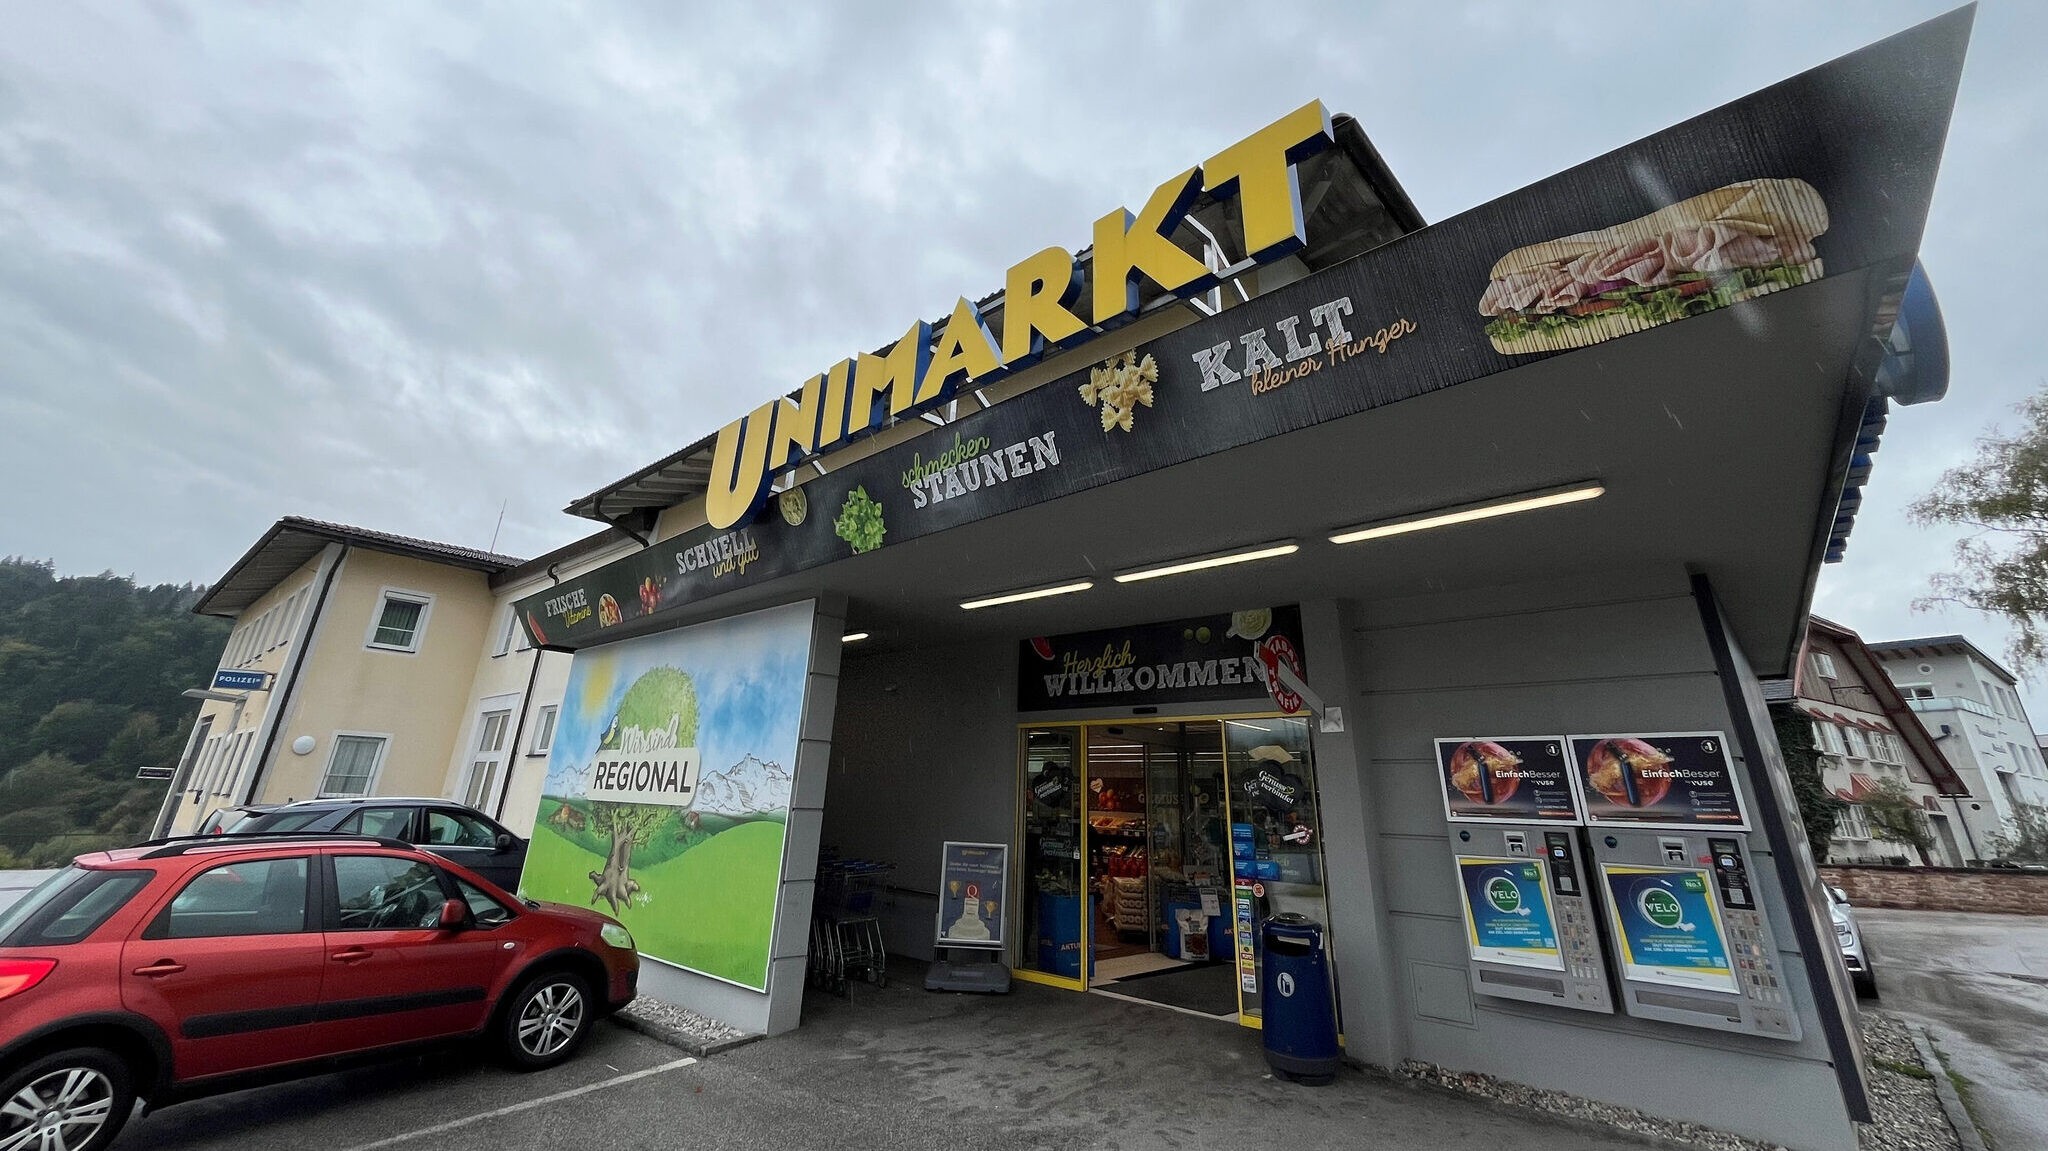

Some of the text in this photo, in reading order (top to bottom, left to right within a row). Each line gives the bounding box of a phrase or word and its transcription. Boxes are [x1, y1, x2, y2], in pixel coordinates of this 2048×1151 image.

[705, 98, 1330, 530] UNIMARKT
[1192, 297, 1354, 392] KALT
[1250, 318, 1417, 396] kleiner Hunger
[902, 432, 990, 488] schmecken
[910, 430, 1060, 509] STAUNEN
[675, 529, 757, 575] SCHNELL
[712, 549, 759, 579] und gut
[544, 588, 588, 617] FRISCHE
[1044, 656, 1266, 697] WILLKOMMEN
[1063, 640, 1136, 678] Herzlich
[219, 675, 256, 684] POLIZEI
[620, 717, 677, 756] Wir sind
[593, 760, 691, 793] REGIONAL
[1259, 770, 1287, 792] Genuss
[1495, 769, 1561, 779] EinfachBesser
[1641, 769, 1721, 779] EinfachBesser
[1490, 890, 1518, 899] VELO
[1645, 902, 1680, 913] VELO
